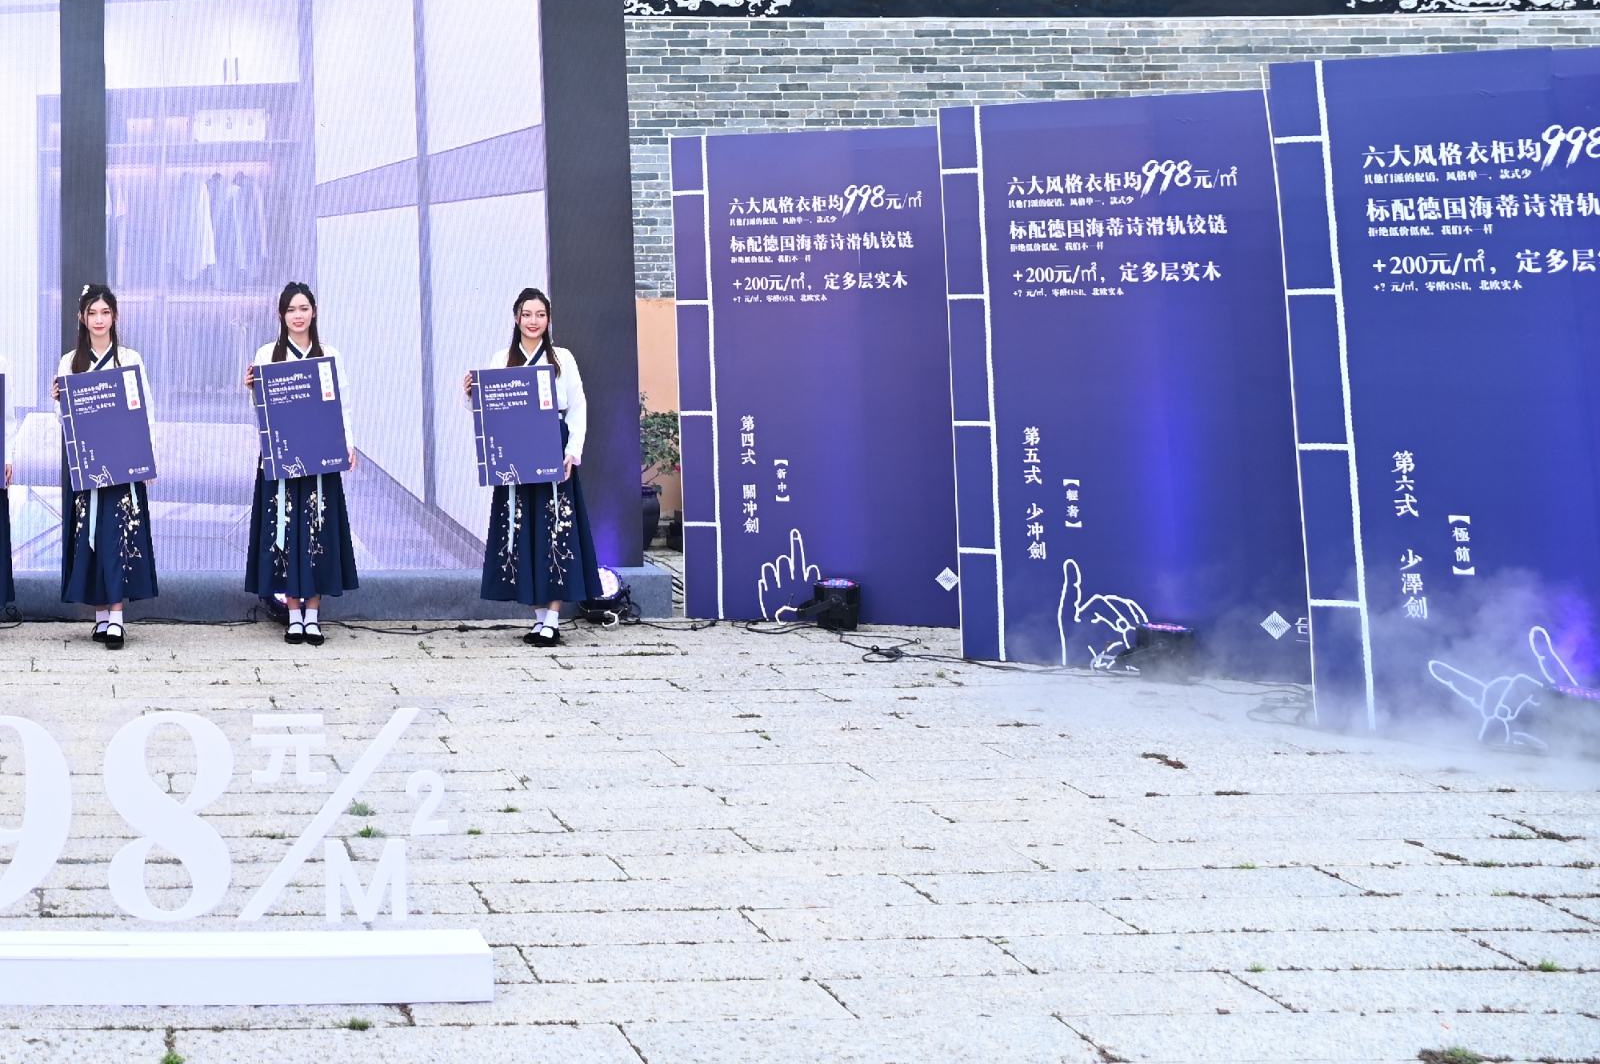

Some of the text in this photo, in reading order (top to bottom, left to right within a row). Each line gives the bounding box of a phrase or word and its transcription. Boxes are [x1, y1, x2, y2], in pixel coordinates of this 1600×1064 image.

[1009, 214, 1228, 240] 标配德国海蒂诗滑轨铰链
[730, 231, 915, 253] 标配德国海蒂诗滑轨铰链
